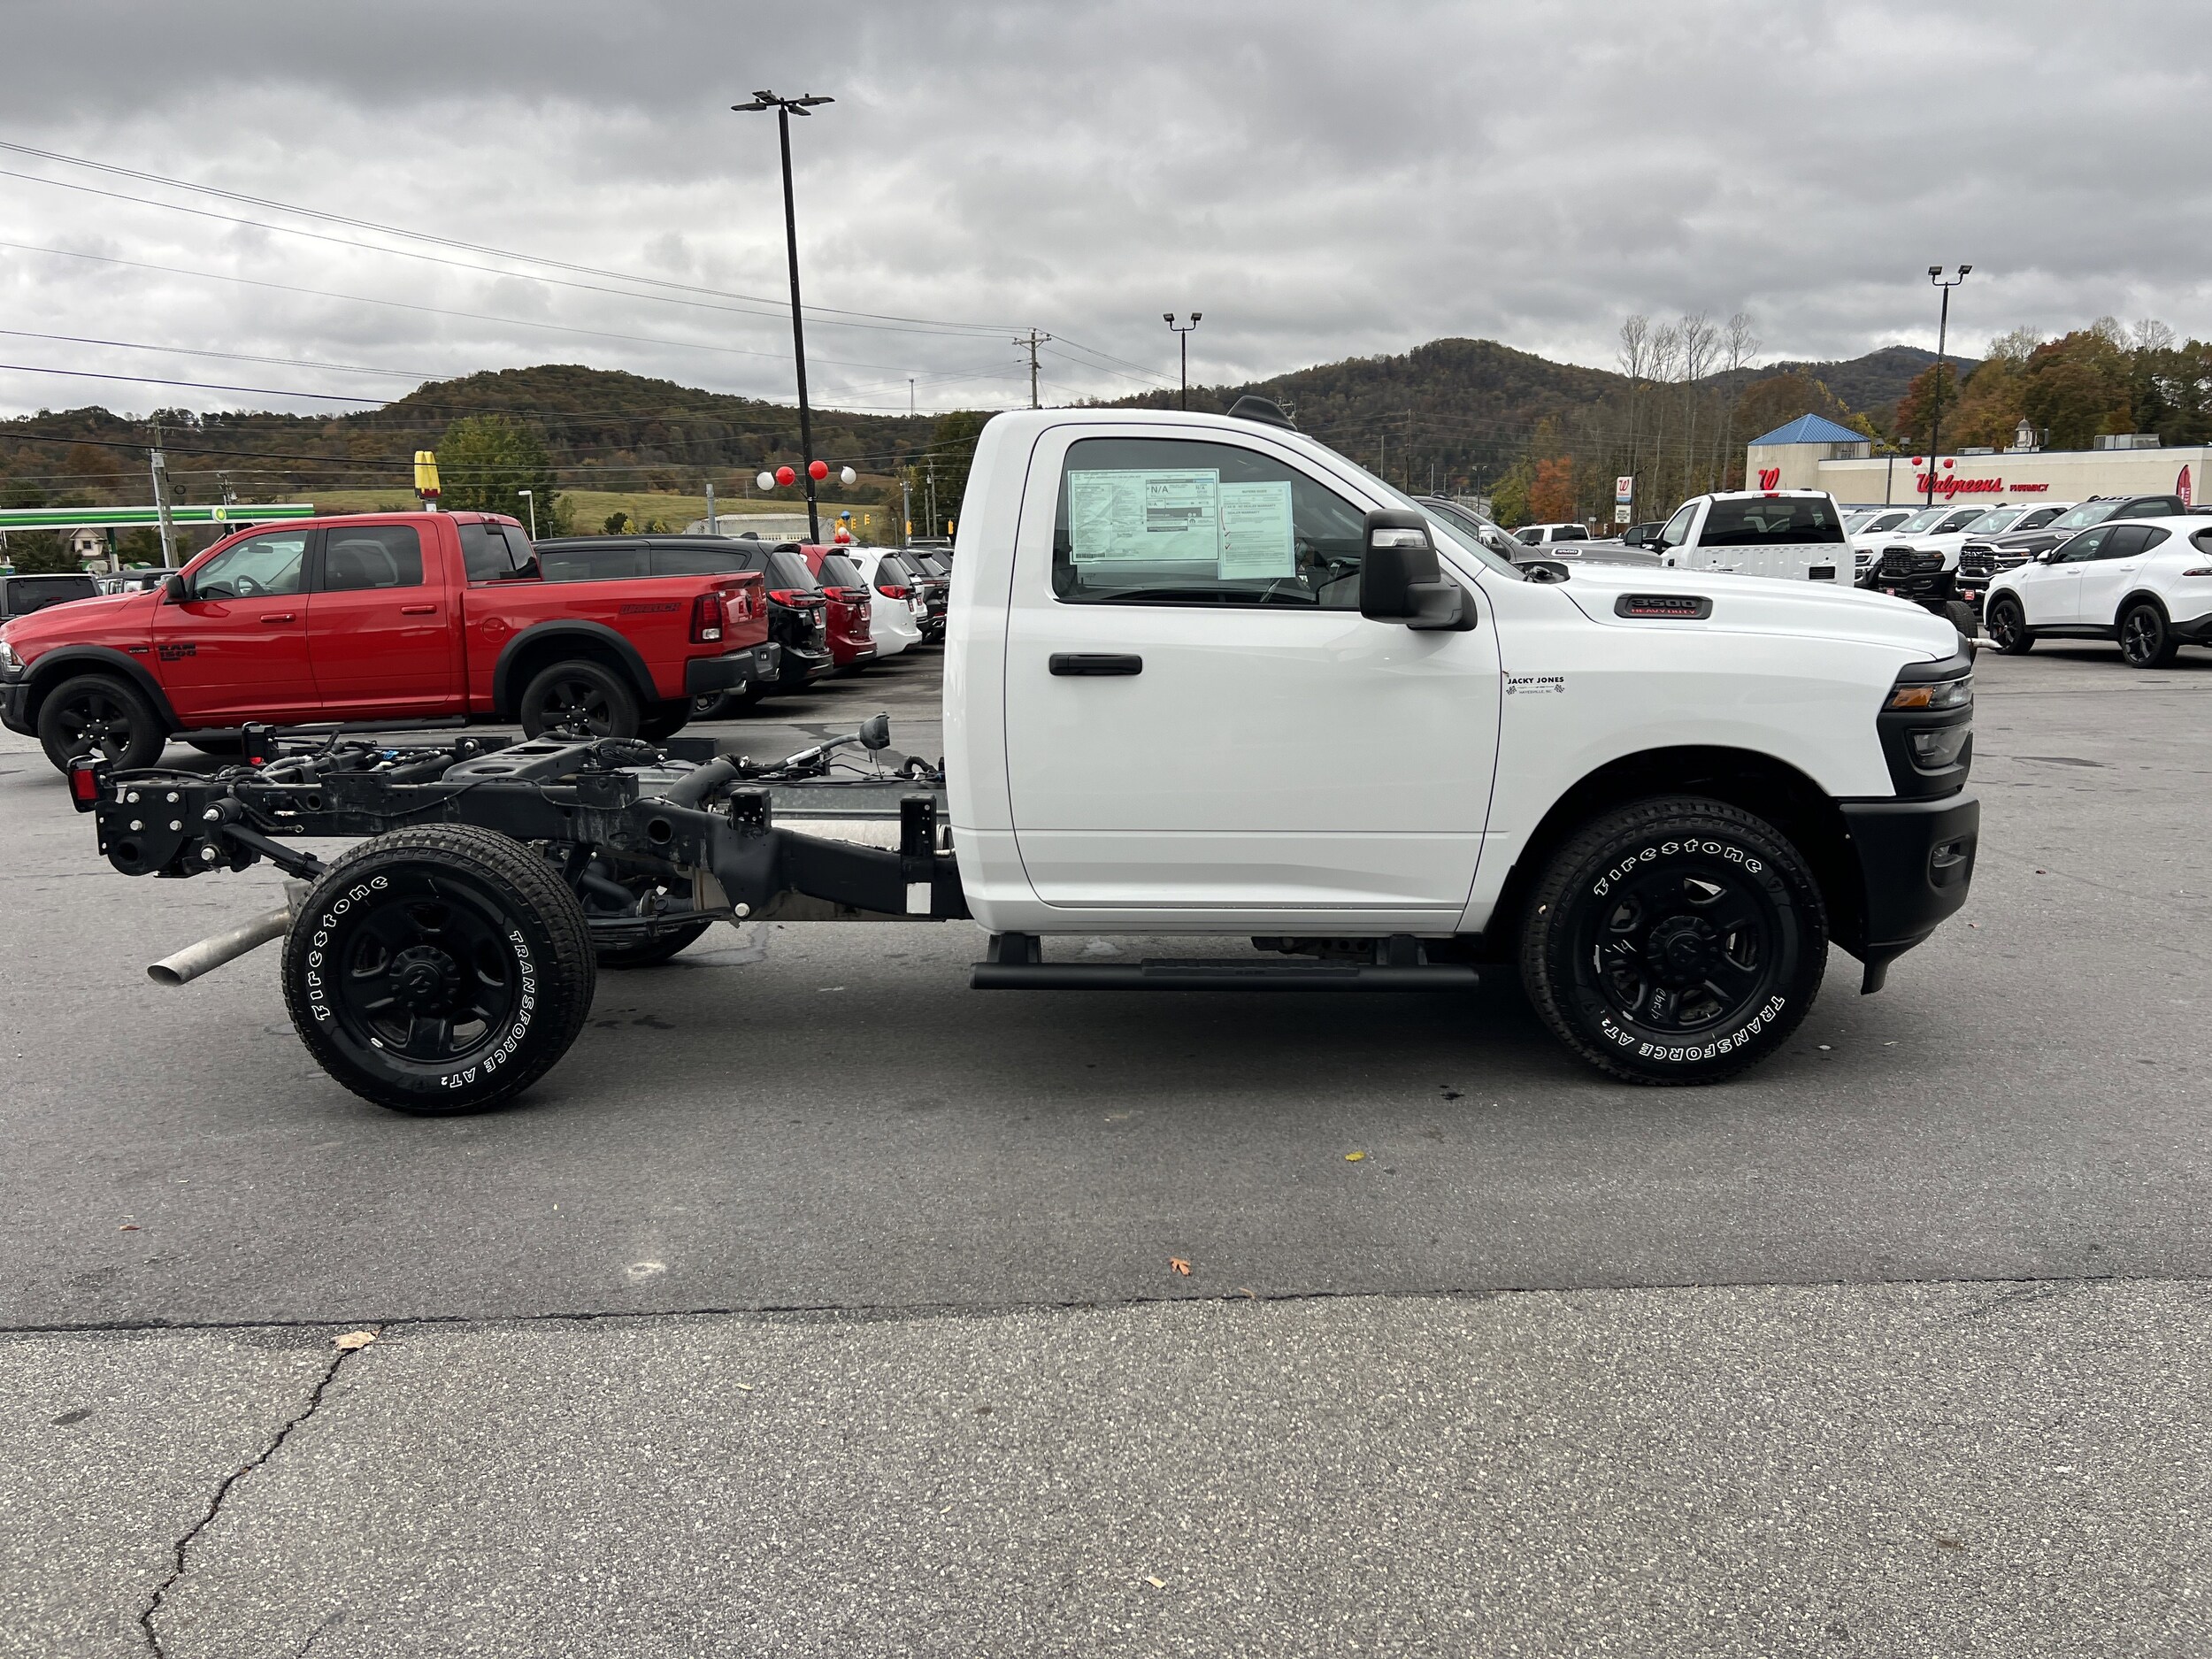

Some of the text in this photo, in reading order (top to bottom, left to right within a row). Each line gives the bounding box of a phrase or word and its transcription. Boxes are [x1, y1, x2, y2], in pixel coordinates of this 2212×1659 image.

[1916, 472, 2003, 500] Walgreens
[1632, 598, 1697, 608] 3500
[484, 930, 535, 1072] TRANSFORCE
[1639, 995, 1786, 1062] TRANSFORCE
